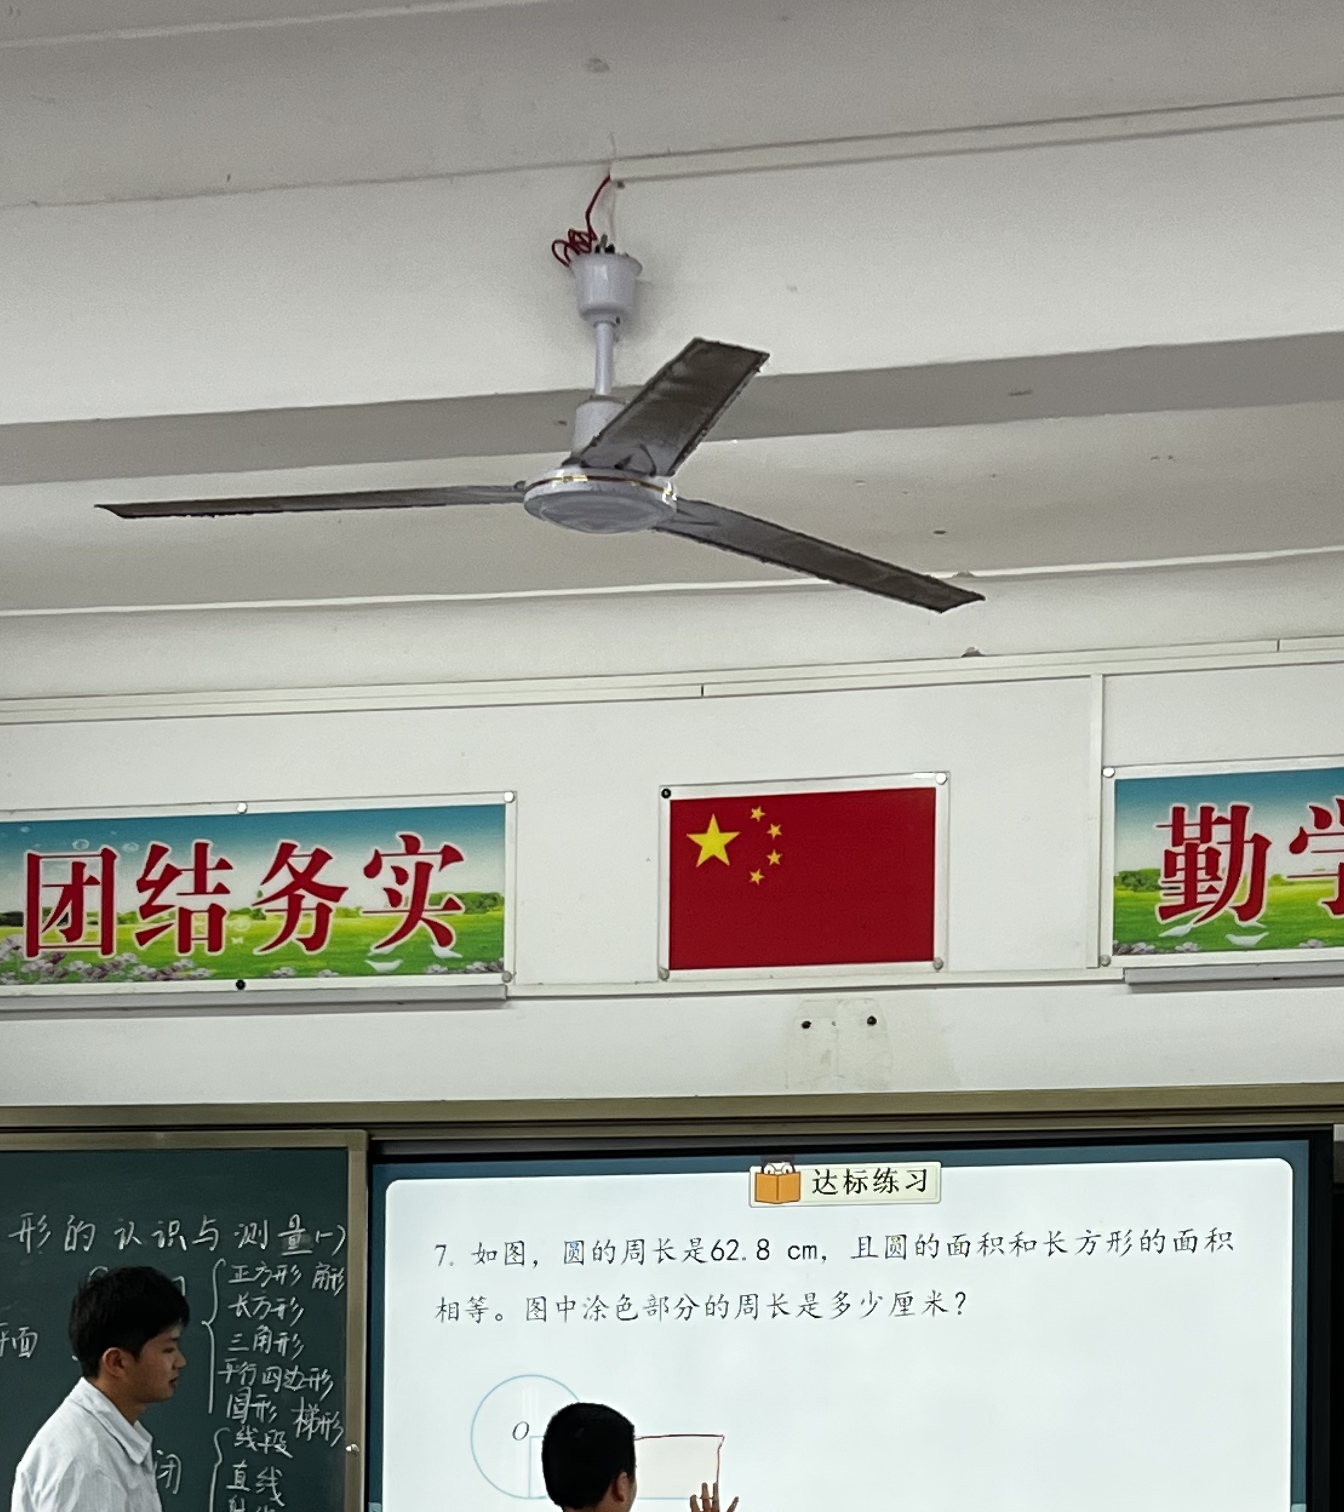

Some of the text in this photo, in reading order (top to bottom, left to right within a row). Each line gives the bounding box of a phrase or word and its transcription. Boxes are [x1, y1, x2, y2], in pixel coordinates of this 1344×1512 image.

[24, 831, 466, 959] 团结务实
[811, 1166, 930, 1196] 达标练习
[228, 1260, 303, 1288] 正方形
[227, 1290, 305, 1327] 长方形
[227, 1324, 305, 1361] 三角形
[217, 1357, 335, 1402] 平行四边形
[226, 1385, 277, 1424] 圆形
[290, 1396, 345, 1448] 梯形
[233, 1424, 294, 1459] 线段
[225, 1459, 286, 1507] 直线
